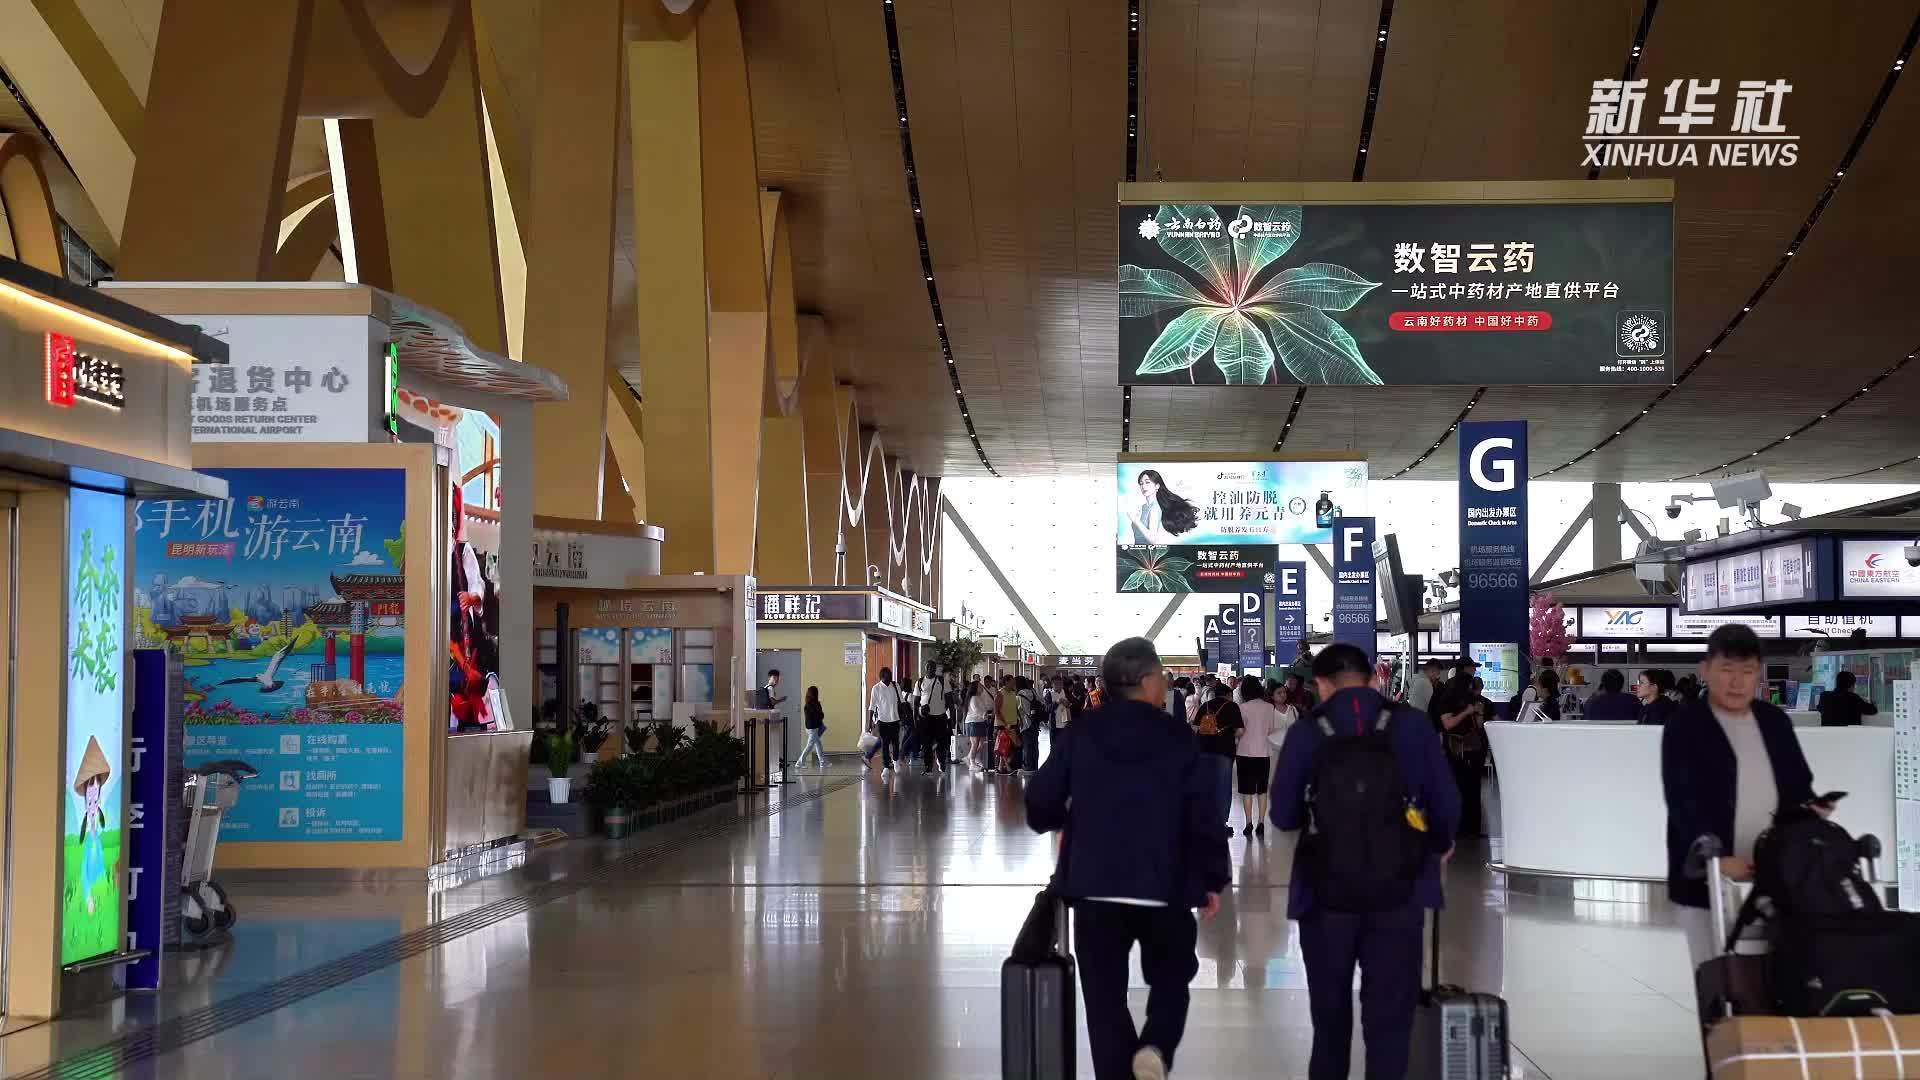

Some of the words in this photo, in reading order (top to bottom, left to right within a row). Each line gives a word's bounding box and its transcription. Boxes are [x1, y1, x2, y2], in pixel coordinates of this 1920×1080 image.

[1393, 241, 1536, 274] 数智云药
[1391, 281, 1620, 300] 一站式中药材产地直供平台
[1403, 315, 1468, 327] 云南好药材
[1474, 315, 1539, 327] 中国好中药
[191, 396, 289, 412] 机场服务点
[197, 415, 233, 424] GOODS
[235, 415, 275, 424] RETURN
[277, 415, 317, 424] CENTER
[259, 426, 304, 435] AIRPORT
[1469, 437, 1515, 492] G
[1212, 490, 1278, 505] 控油防脱
[1203, 506, 1286, 521] 就用养元青
[1467, 506, 1517, 519] 国内出发办票区
[243, 512, 369, 561] 游云南
[1343, 527, 1364, 562] F
[1197, 550, 1239, 561] 数智云药
[1282, 568, 1298, 595] E
[1468, 573, 1518, 588] 96566
[1243, 592, 1260, 613] D
[1222, 608, 1236, 626] C
[1338, 613, 1370, 624] 96566
[1205, 618, 1220, 634] A
